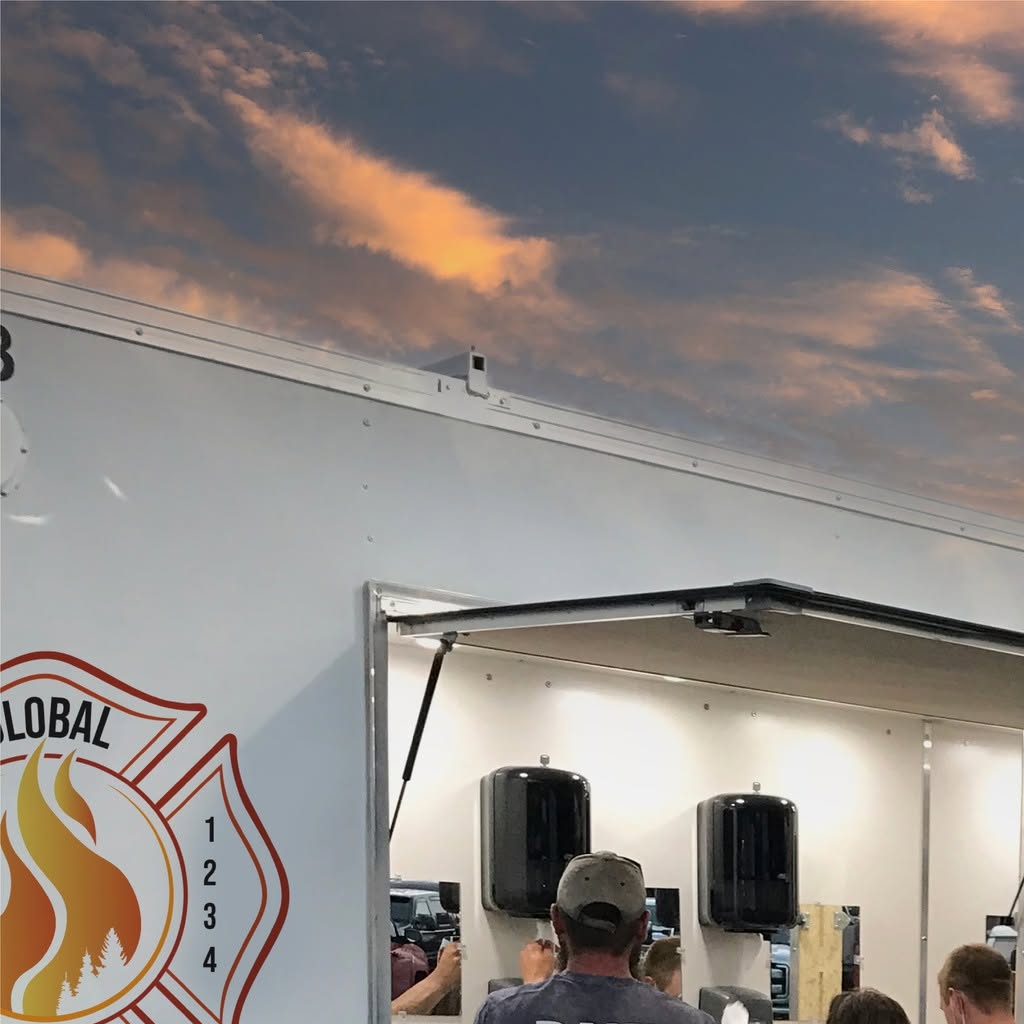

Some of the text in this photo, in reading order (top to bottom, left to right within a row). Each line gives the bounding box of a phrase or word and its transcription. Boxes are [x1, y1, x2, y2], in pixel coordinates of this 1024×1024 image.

[0, 696, 111, 750] LOBAL
[205, 816, 215, 843] 1
[203, 859, 217, 886] 2
[203, 902, 217, 930] 3
[203, 946, 217, 973] 4
